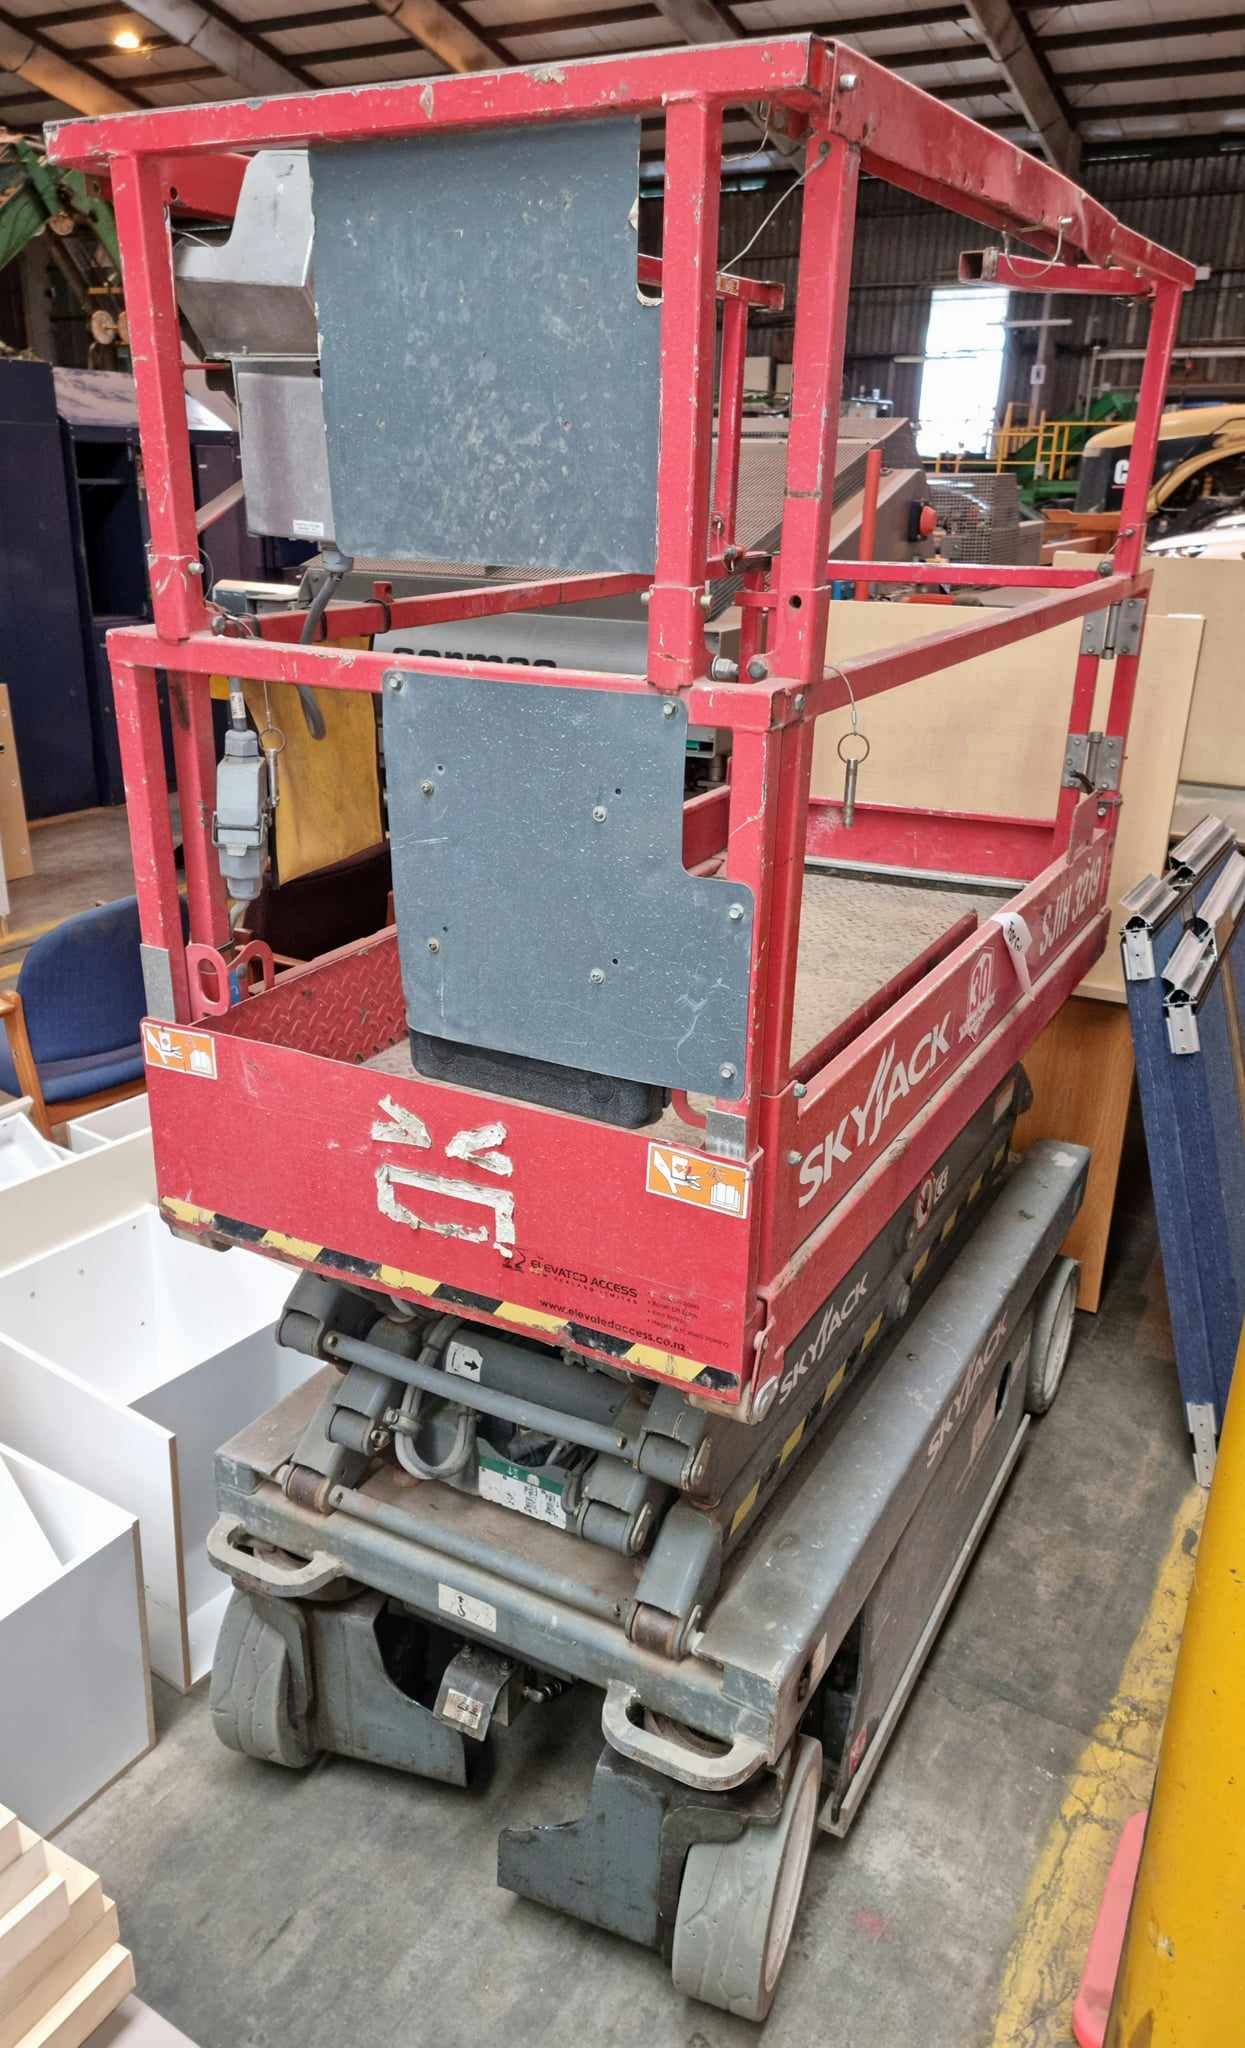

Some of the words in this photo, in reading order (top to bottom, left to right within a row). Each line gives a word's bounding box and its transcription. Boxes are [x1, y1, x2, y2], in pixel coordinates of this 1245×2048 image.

[799, 1010, 952, 1209] SKYJACK
[591, 1277, 638, 1298] ACCESS
[778, 1271, 868, 1405] SKYJACK
